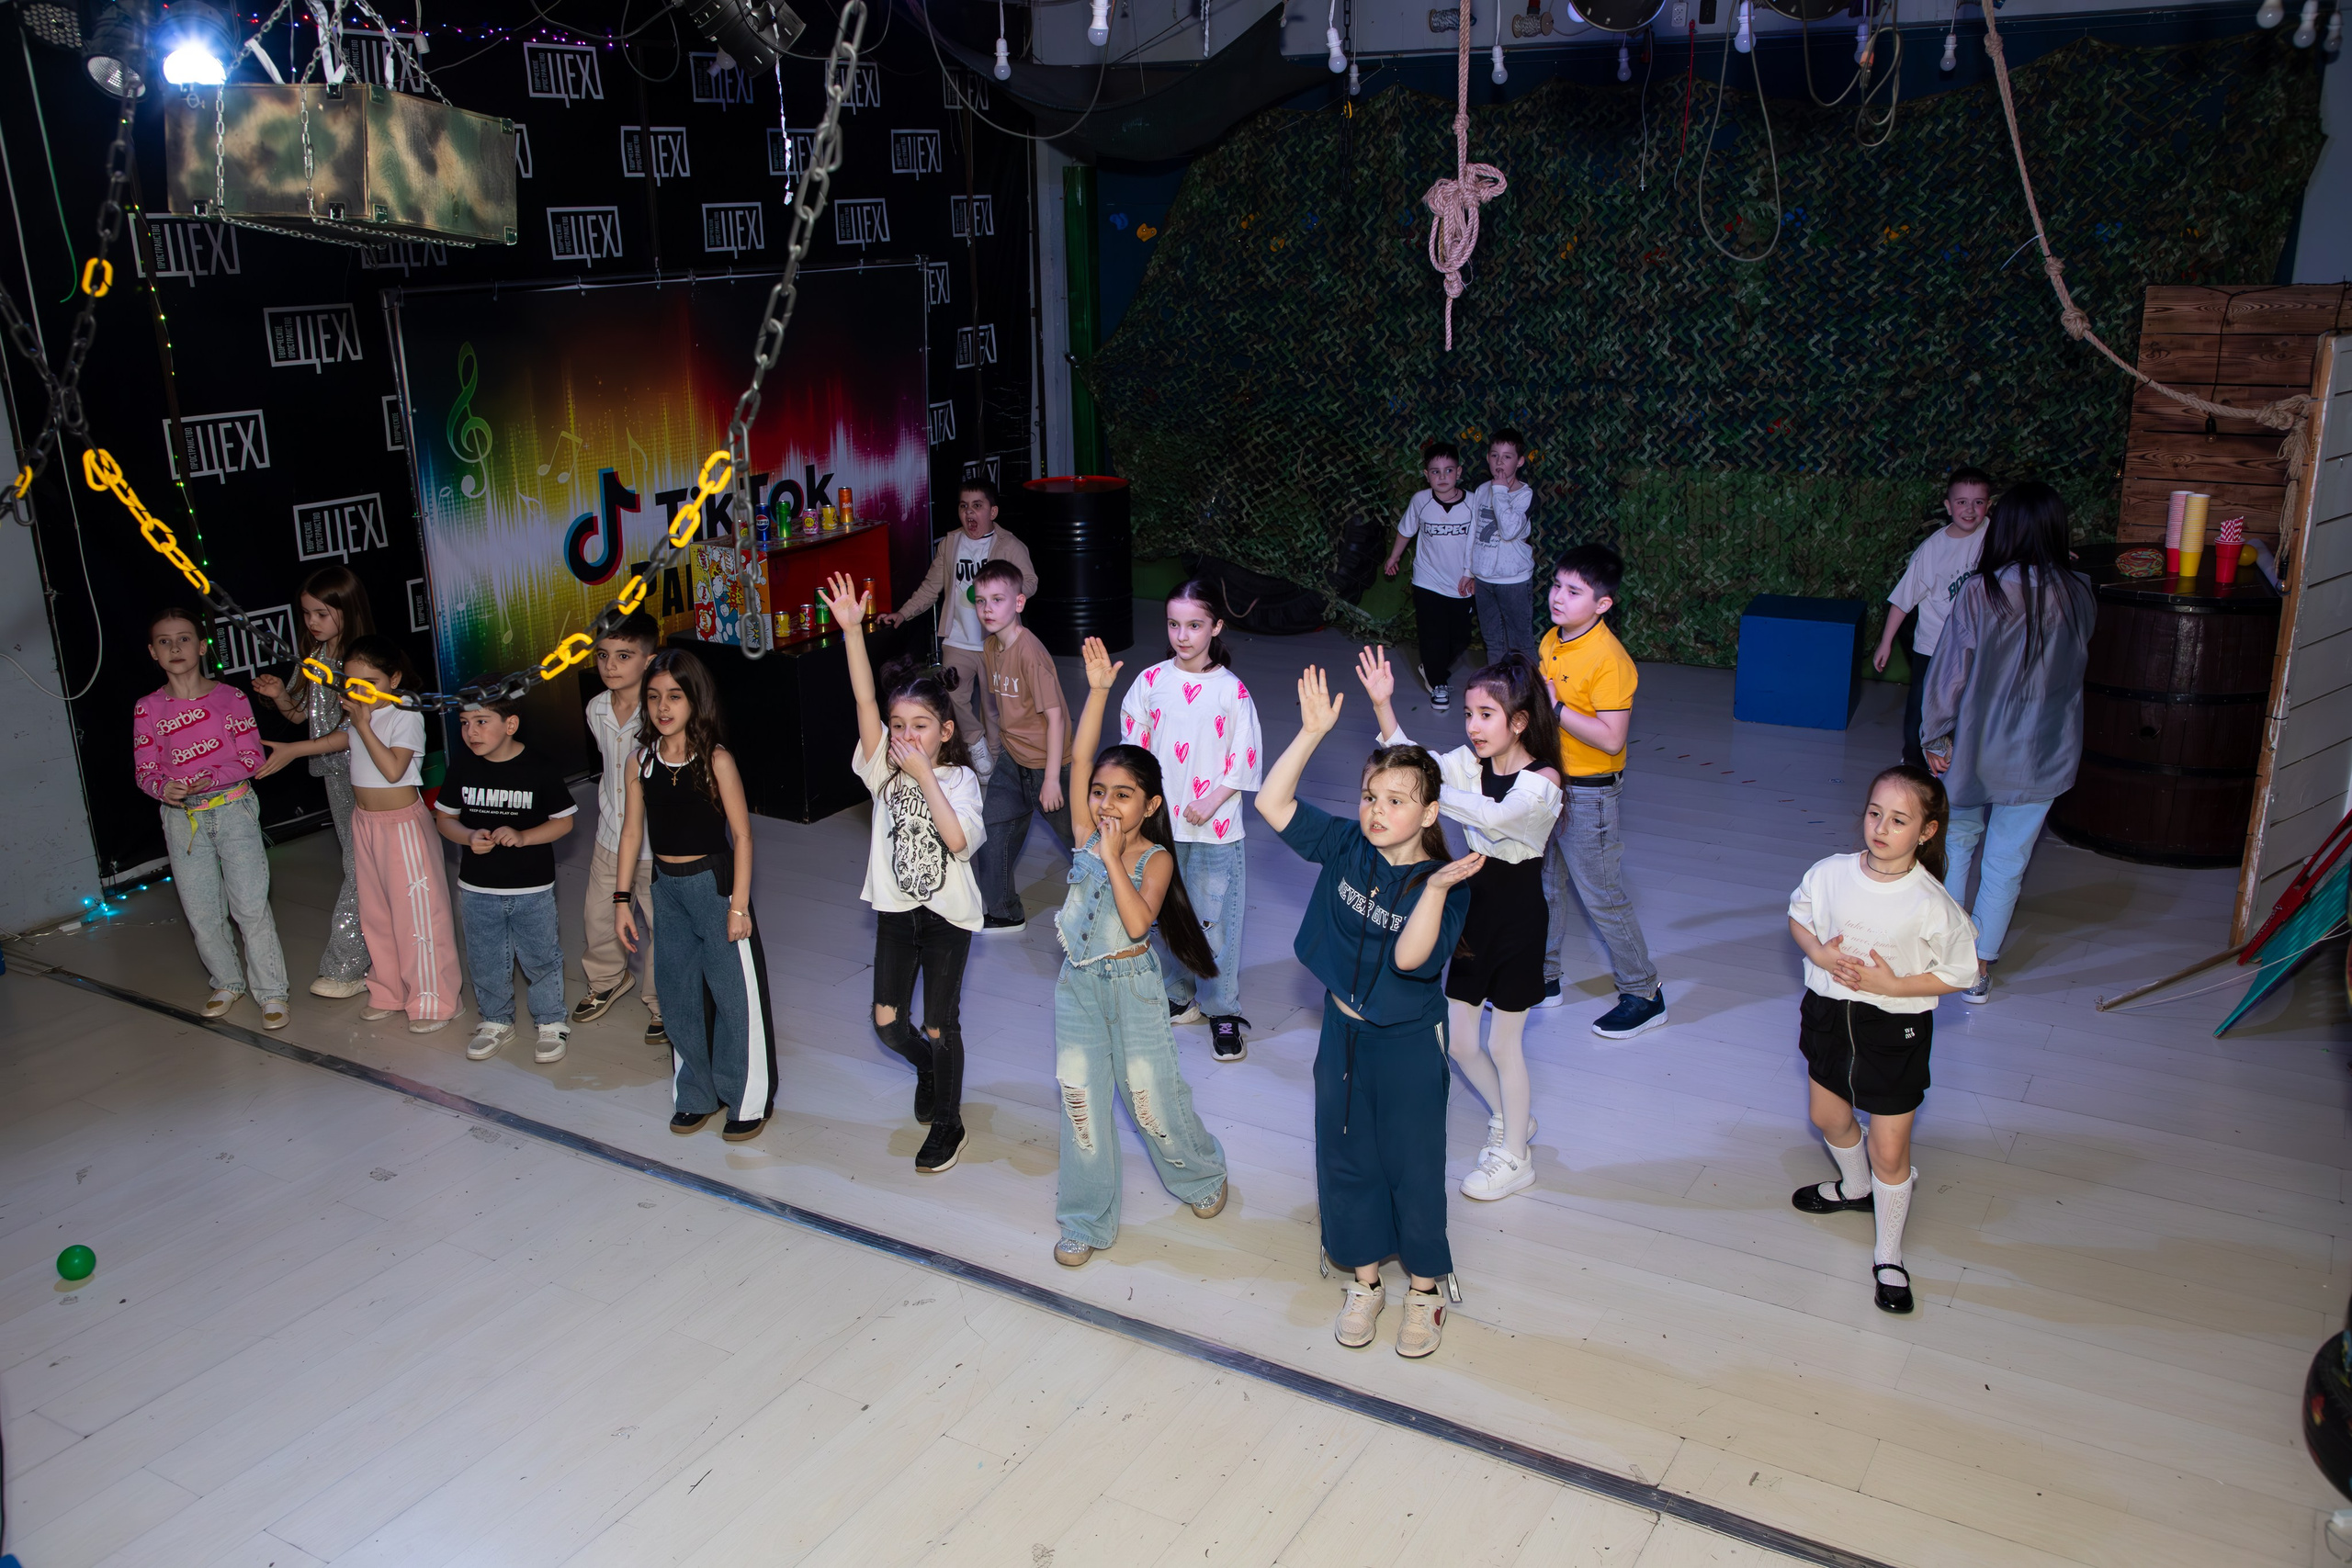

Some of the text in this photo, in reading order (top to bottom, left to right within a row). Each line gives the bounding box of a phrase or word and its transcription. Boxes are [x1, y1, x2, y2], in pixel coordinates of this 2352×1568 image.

[548, 51, 595, 108] ЦЕХ
[907, 136, 938, 181] ЦЕХ
[570, 213, 615, 268] ЦЕХ
[720, 210, 758, 260] ЦЕХ
[850, 205, 881, 251] ЦЕХ
[163, 223, 233, 288] ЦЕХ
[295, 311, 356, 375] ЦЕХ
[196, 419, 262, 485] ЦЕХ
[323, 502, 380, 565] ЦЕХ
[1424, 523, 1470, 537] RESPECT
[156, 708, 205, 736] Barbie
[172, 738, 220, 765] Barbie
[461, 785, 533, 809] CHAMPION
